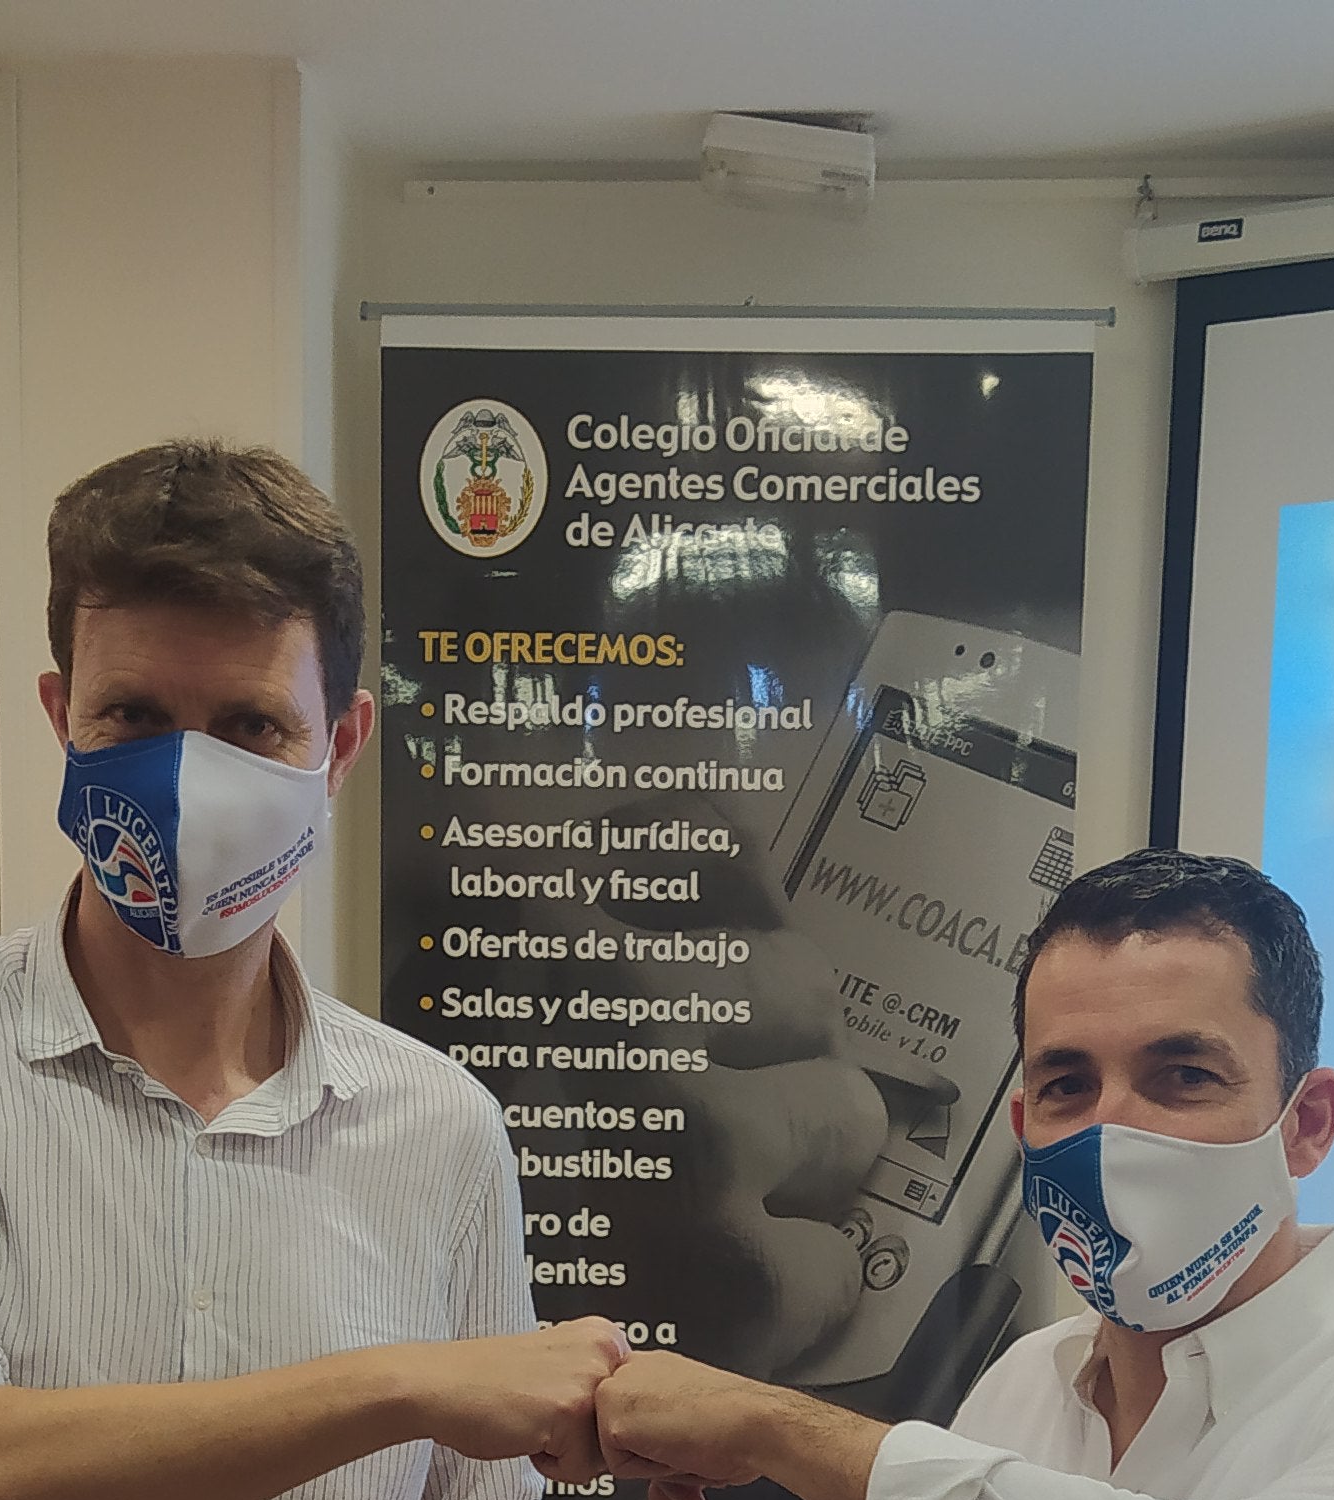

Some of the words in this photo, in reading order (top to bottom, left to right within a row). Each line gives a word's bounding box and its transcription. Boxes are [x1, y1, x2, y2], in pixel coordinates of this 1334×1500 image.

[566, 413, 717, 457] Colegio
[725, 414, 853, 453] Oficial
[860, 417, 909, 453] de
[564, 463, 725, 505] Agentes
[733, 465, 982, 503] Comerciales
[565, 512, 615, 548] de
[418, 630, 459, 664] TE
[464, 631, 685, 667] OFRECEMOS:
[443, 693, 607, 731] Respaldo
[613, 697, 814, 733] profesional
[443, 753, 628, 790] Formación
[634, 759, 786, 793] continua
[442, 815, 594, 852] Asesoría
[599, 819, 741, 859] jurídica,
[239, 874, 276, 901] NUNCA
[450, 866, 575, 900] laboral
[580, 874, 605, 905] y
[610, 868, 701, 902] fiscal
[442, 926, 569, 960] Ofertas
[574, 929, 619, 961] de
[624, 931, 751, 969] trabajo
[441, 987, 534, 1020] Salas
[539, 996, 563, 1026] y
[567, 989, 753, 1027] despachos
[448, 1043, 529, 1069] para
[535, 1040, 709, 1072] reuniones
[641, 1107, 685, 1132] en
[517, 1146, 673, 1180] bustibles
[567, 1207, 611, 1238] de
[1185, 1243, 1221, 1277] NUNCA
[1181, 1263, 1215, 1295] FINAL
[655, 1321, 678, 1345] a
